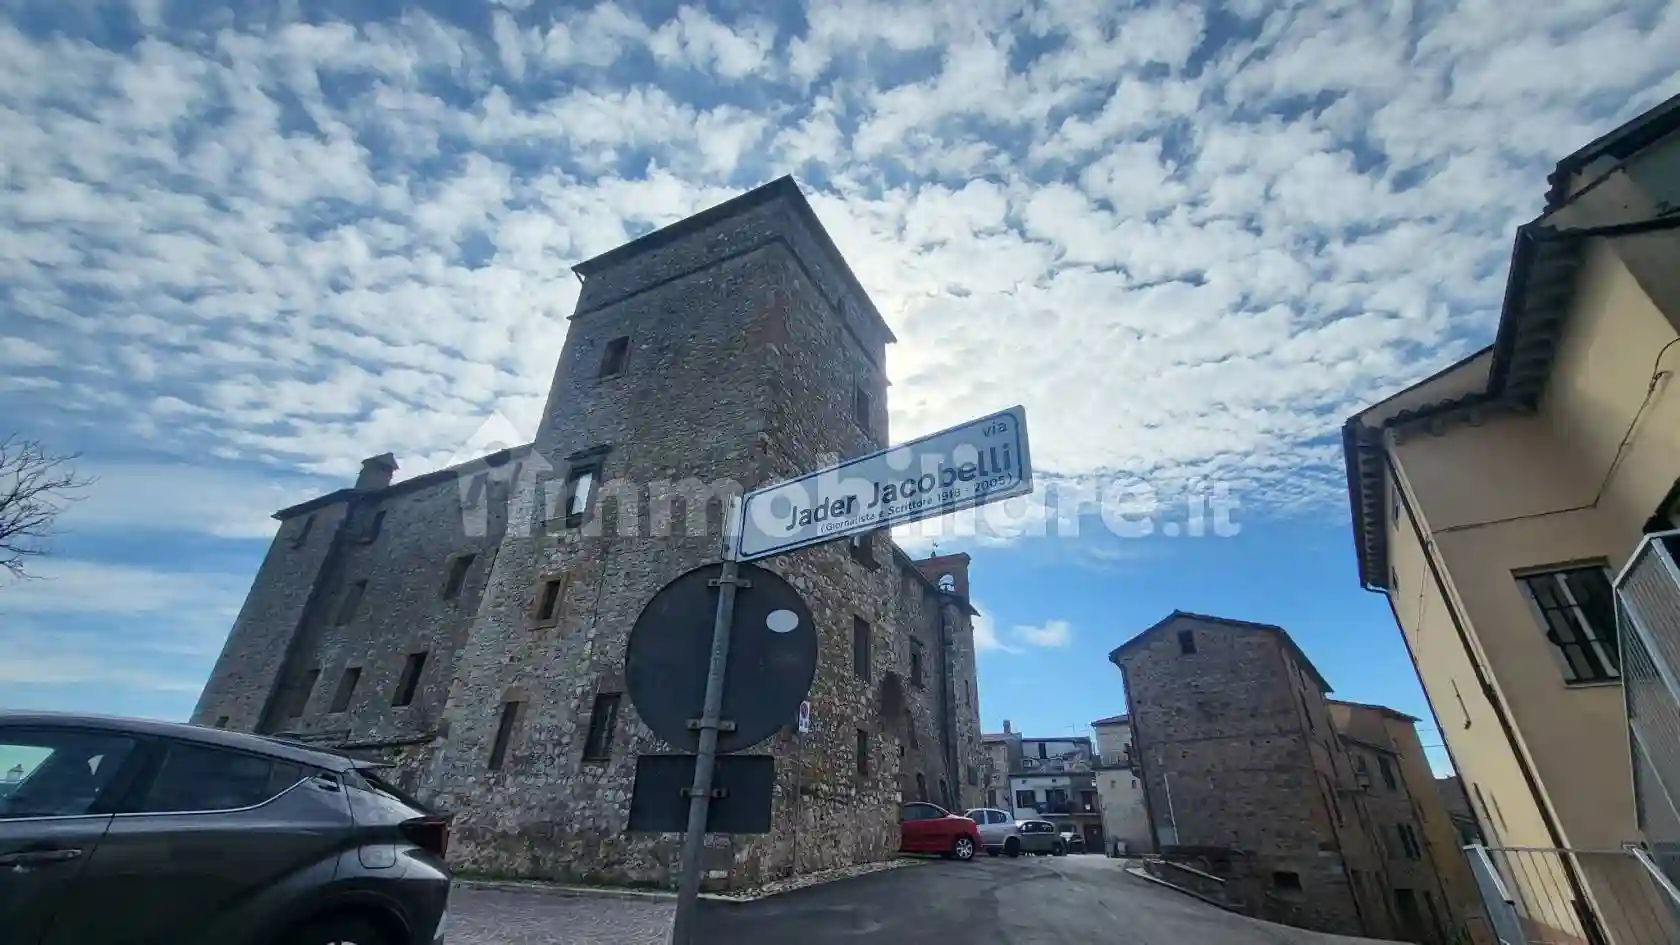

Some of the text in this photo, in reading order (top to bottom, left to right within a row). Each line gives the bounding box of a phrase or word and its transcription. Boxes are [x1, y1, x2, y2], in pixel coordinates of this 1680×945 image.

[982, 419, 1008, 438] via
[785, 442, 1012, 532] Jader Jacobelli
